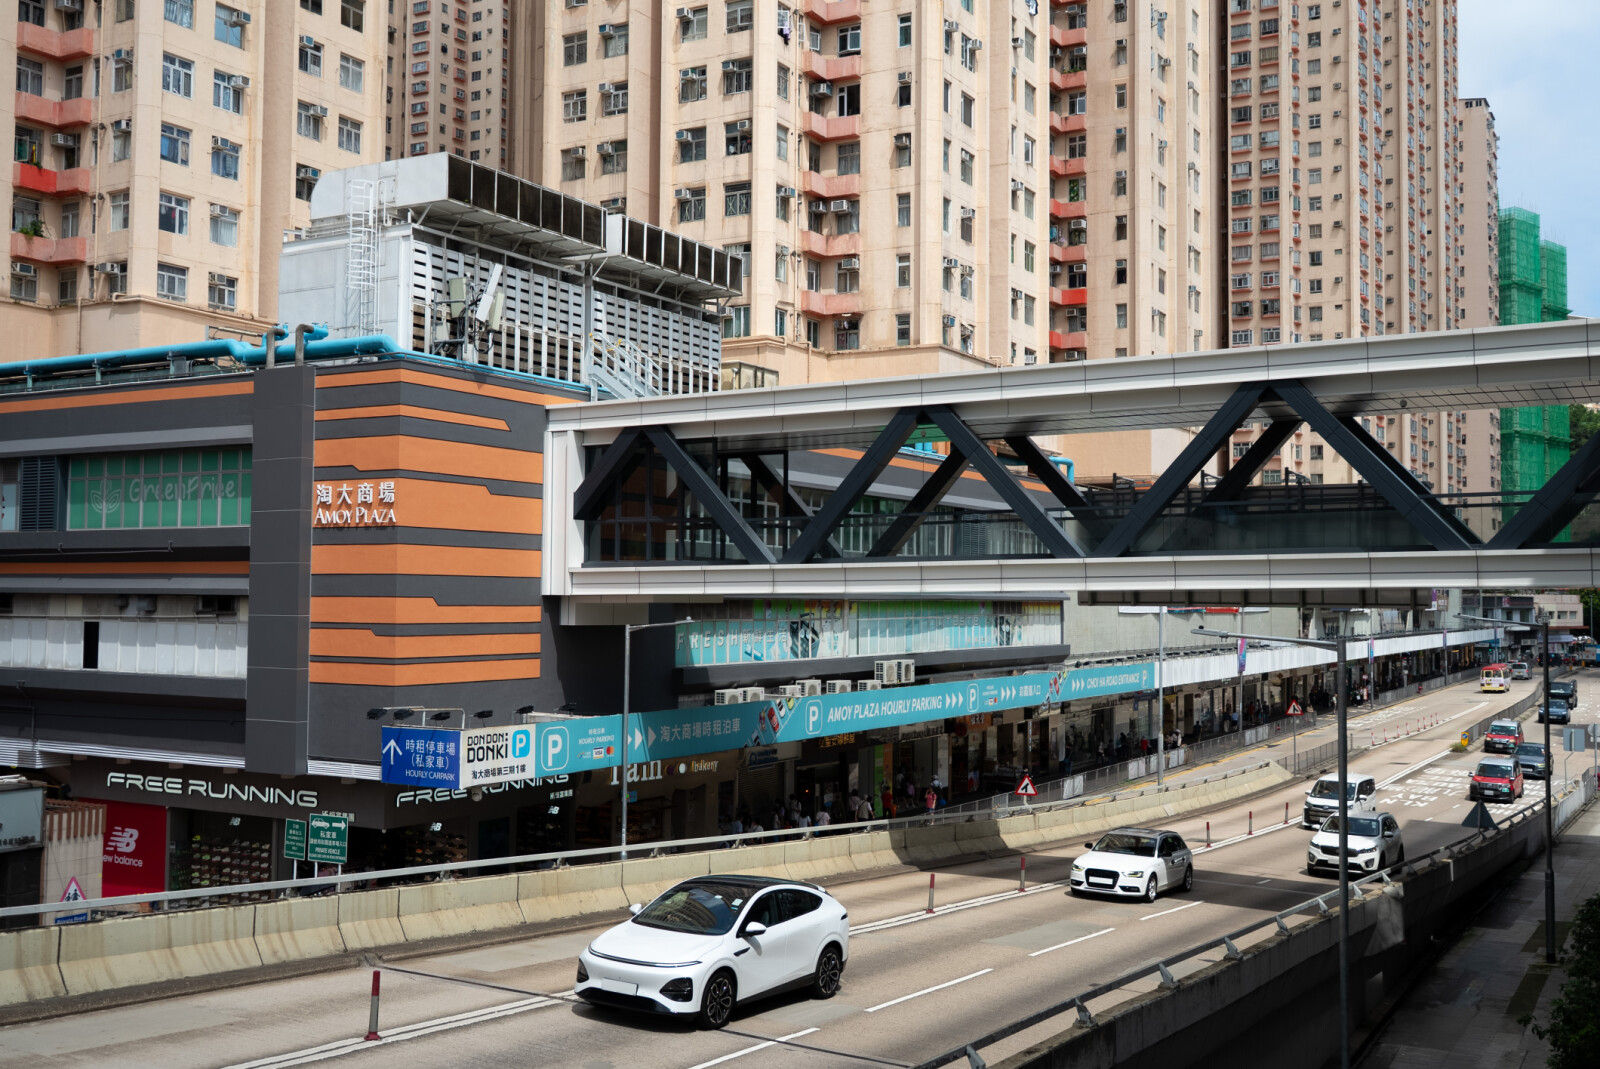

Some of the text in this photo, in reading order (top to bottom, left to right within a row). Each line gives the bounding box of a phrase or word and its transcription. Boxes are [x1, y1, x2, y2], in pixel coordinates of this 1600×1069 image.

[129, 476, 236, 503] GreenPrice
[316, 481, 395, 505] 淘大商場
[314, 506, 397, 524] AMOY PLAZA
[676, 629, 738, 650] FRESH
[1086, 678, 1098, 689] CHOI
[1106, 674, 1118, 686] ROAD
[1118, 672, 1140, 685] ENTRANCE
[827, 696, 943, 722] AMOY PLAZA HOURLY PARKING
[660, 718, 741, 742] 淘大商場時租泊車
[405, 739, 456, 756] 時租停車場
[466, 744, 508, 763] DONKI
[406, 769, 456, 782] HOURLY CARPARK
[692, 760, 719, 772] bakery
[107, 772, 318, 808] FREE RUNNING
[396, 788, 467, 808] FREE
[102, 854, 144, 868] ew balance
